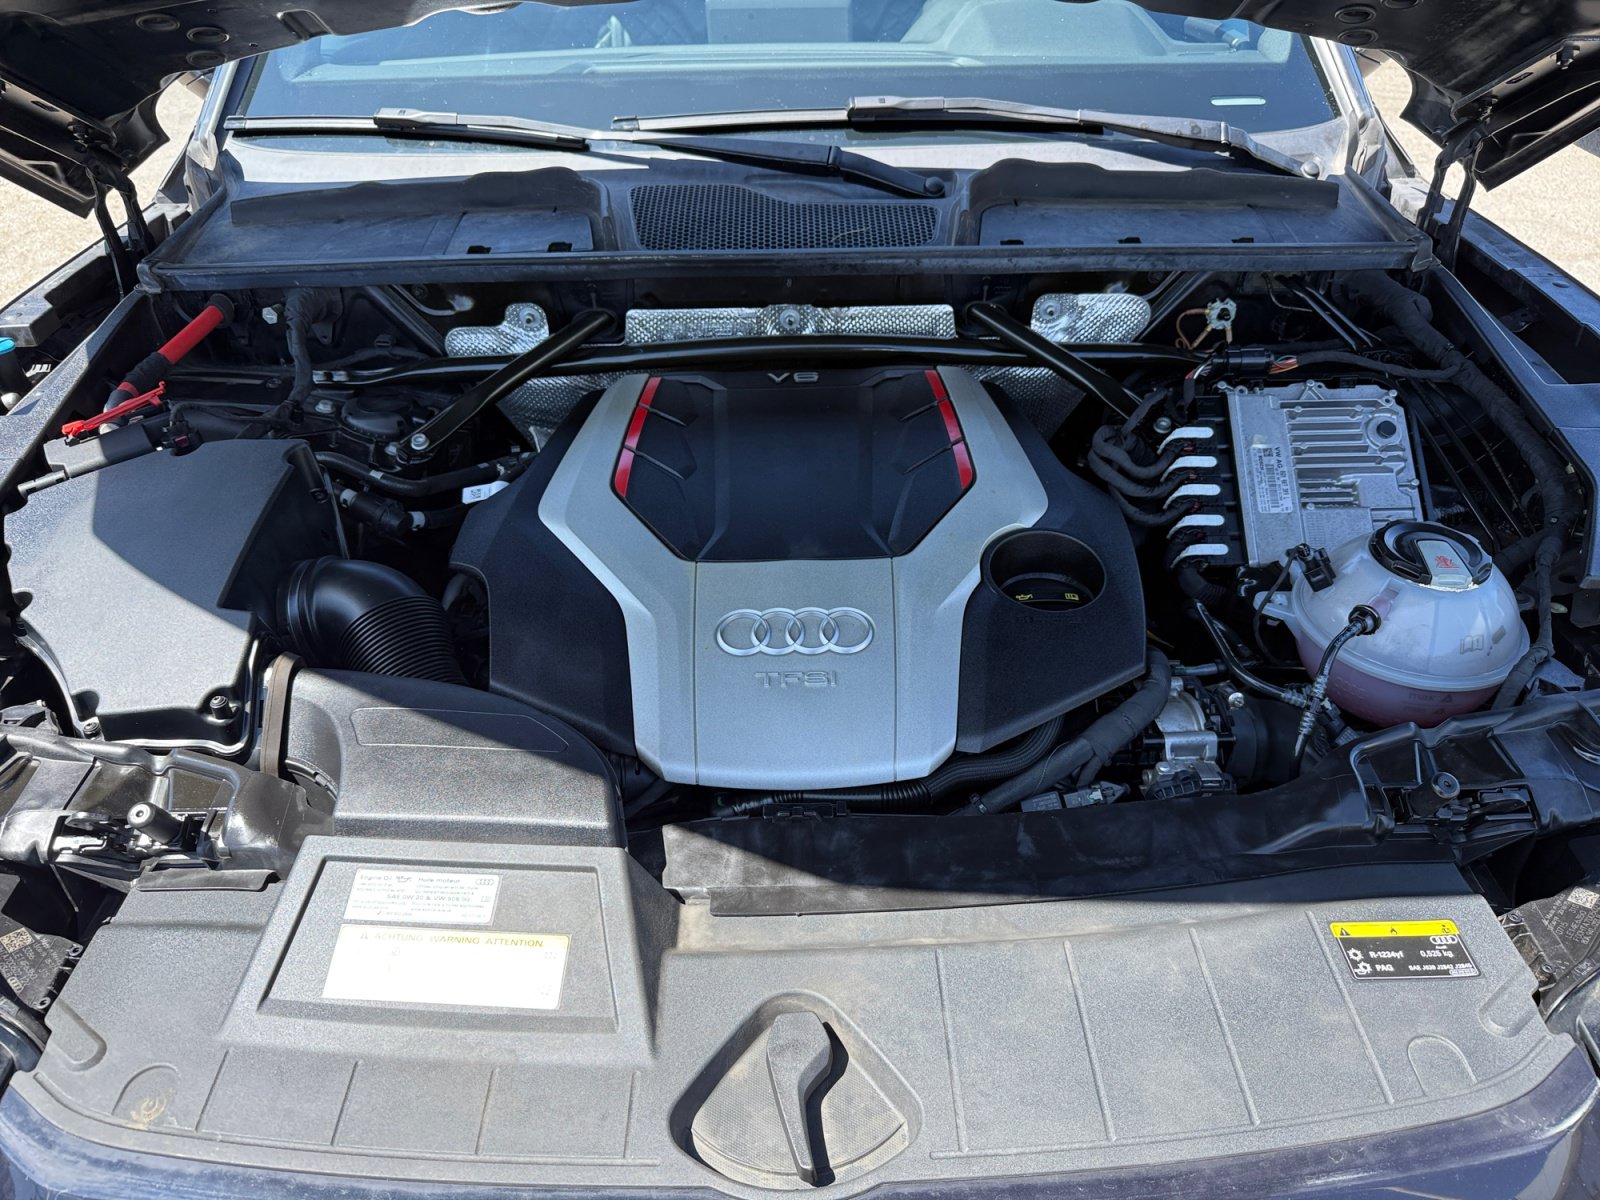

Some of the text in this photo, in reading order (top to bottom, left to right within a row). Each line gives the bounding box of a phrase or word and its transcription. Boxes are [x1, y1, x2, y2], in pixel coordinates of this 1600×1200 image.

[767, 371, 819, 383] V6
[753, 671, 837, 688] TFSI
[374, 932, 543, 948] ACHTUNG WARNING ATTENTION
[1441, 950, 1455, 958] kg
[1375, 964, 1395, 972] PAG
